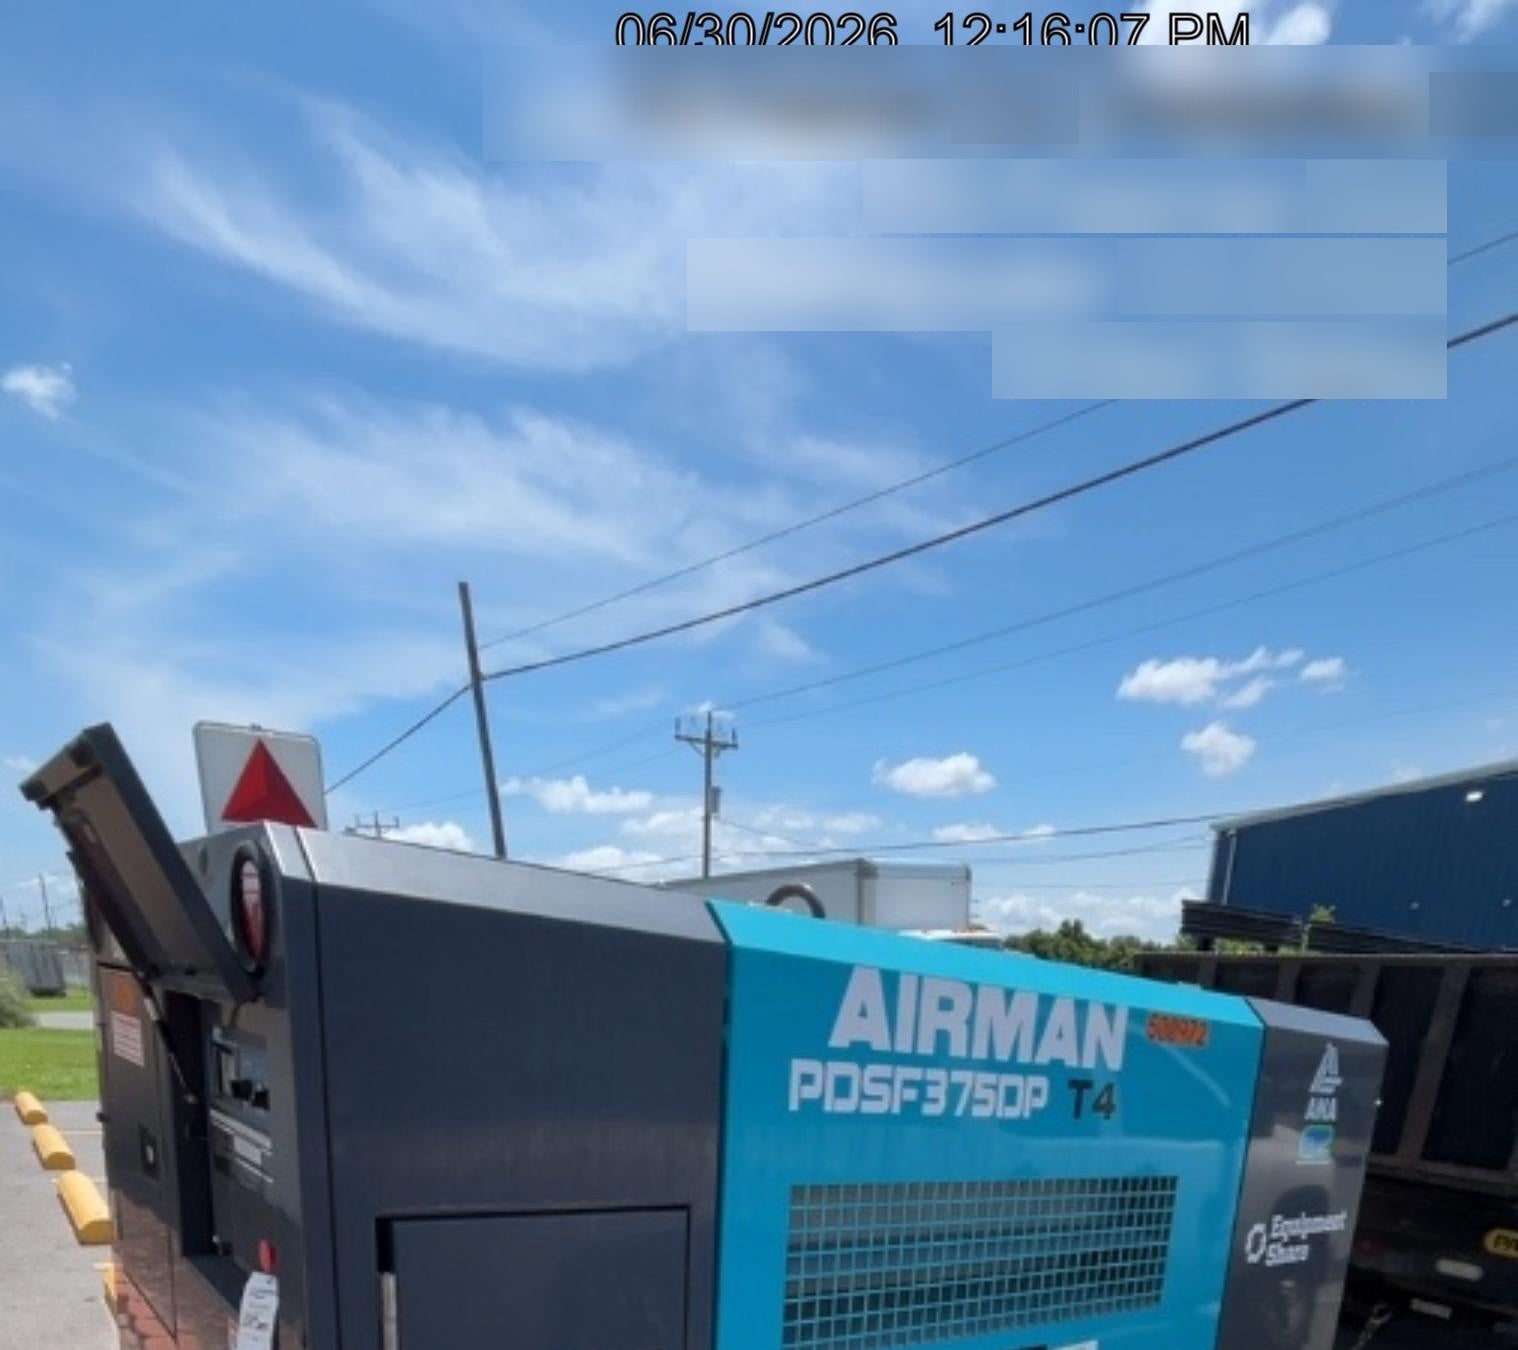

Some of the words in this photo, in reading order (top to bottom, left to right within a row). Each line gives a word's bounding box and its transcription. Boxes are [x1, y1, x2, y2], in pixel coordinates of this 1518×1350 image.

[828, 966, 1129, 1071] AIRMAN
[788, 1059, 1049, 1119] PDSF375DP
[1068, 1079, 1117, 1120] T4
[1271, 1211, 1347, 1241] Equipment
[1265, 1243, 1309, 1267] Share
